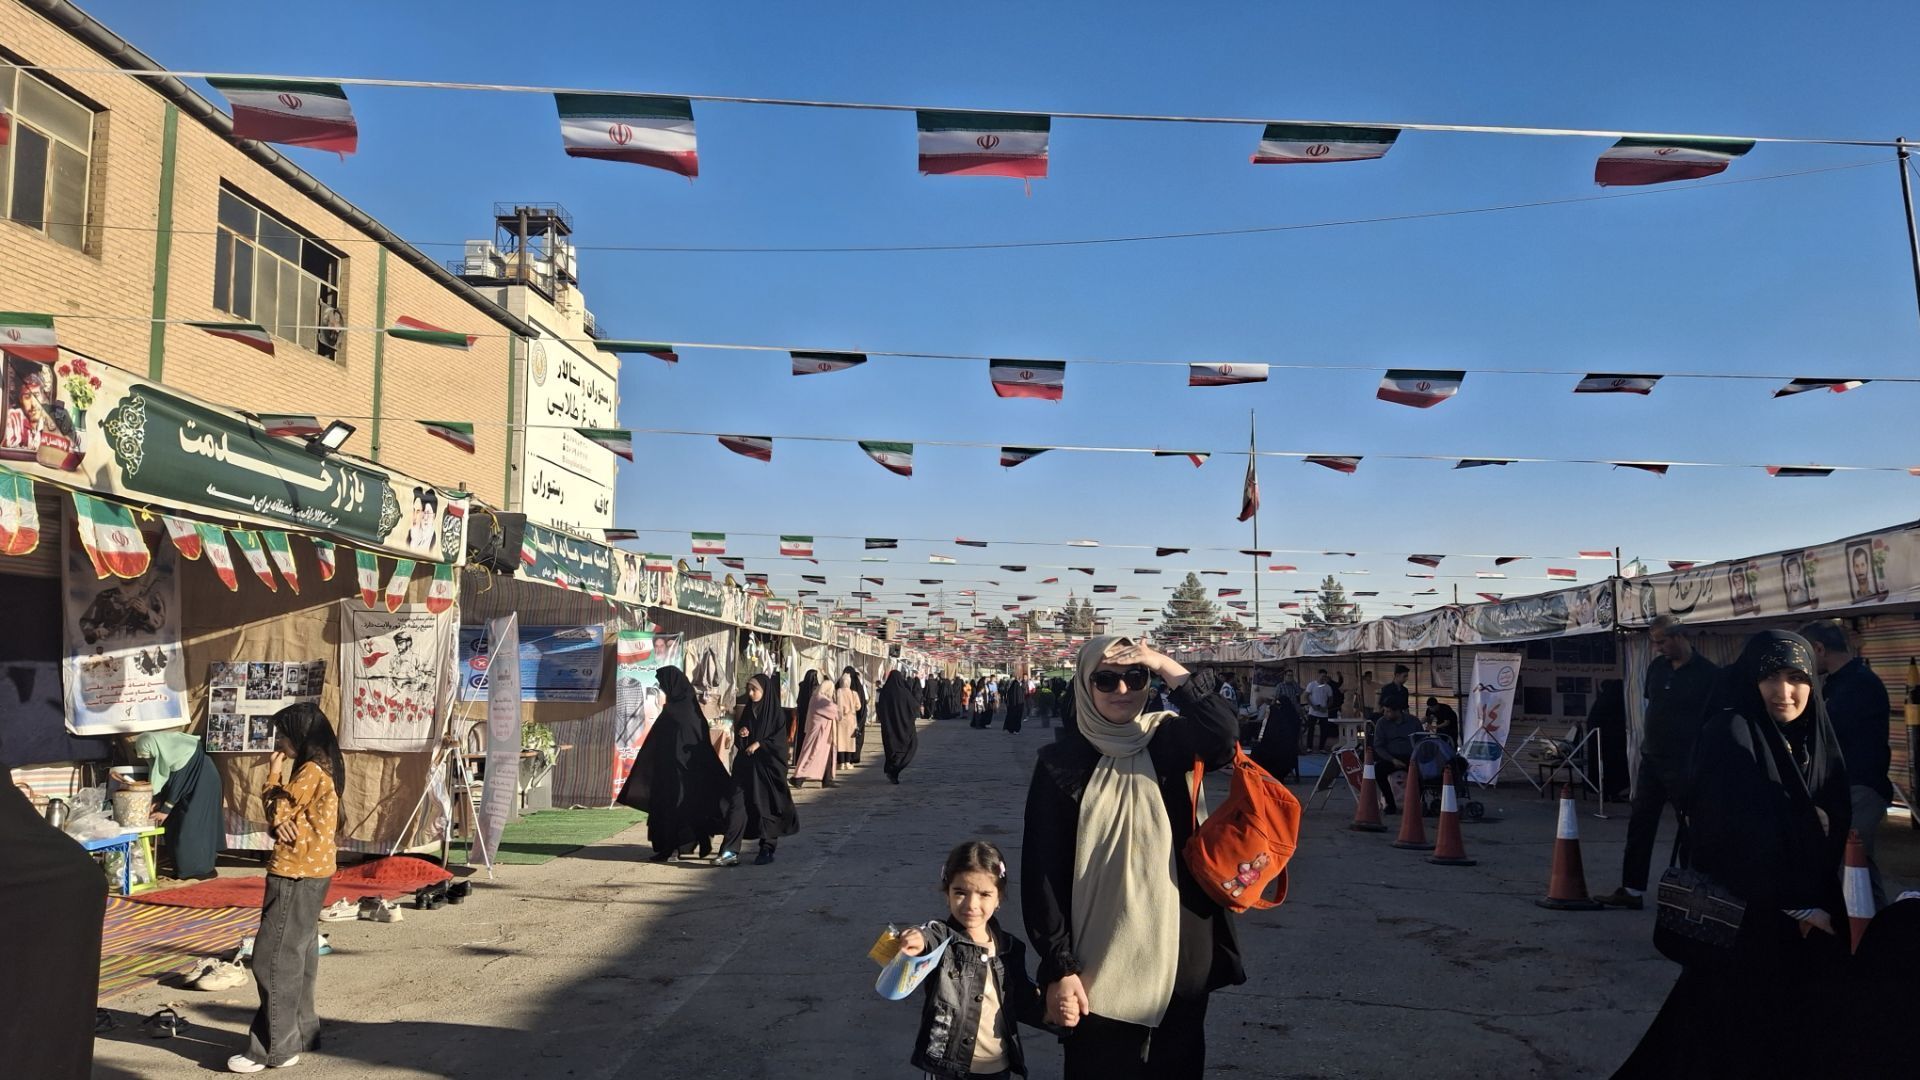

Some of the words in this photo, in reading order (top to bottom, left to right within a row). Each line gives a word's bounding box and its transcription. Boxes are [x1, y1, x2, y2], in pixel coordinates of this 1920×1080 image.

[557, 358, 581, 388] تالار
[586, 380, 612, 412] رستوران
[179, 420, 333, 493] خدمت
[206, 483, 255, 505] همه
[331, 465, 366, 514] بازار
[531, 469, 565, 504] رستوران
[594, 493, 610, 516] کافه
